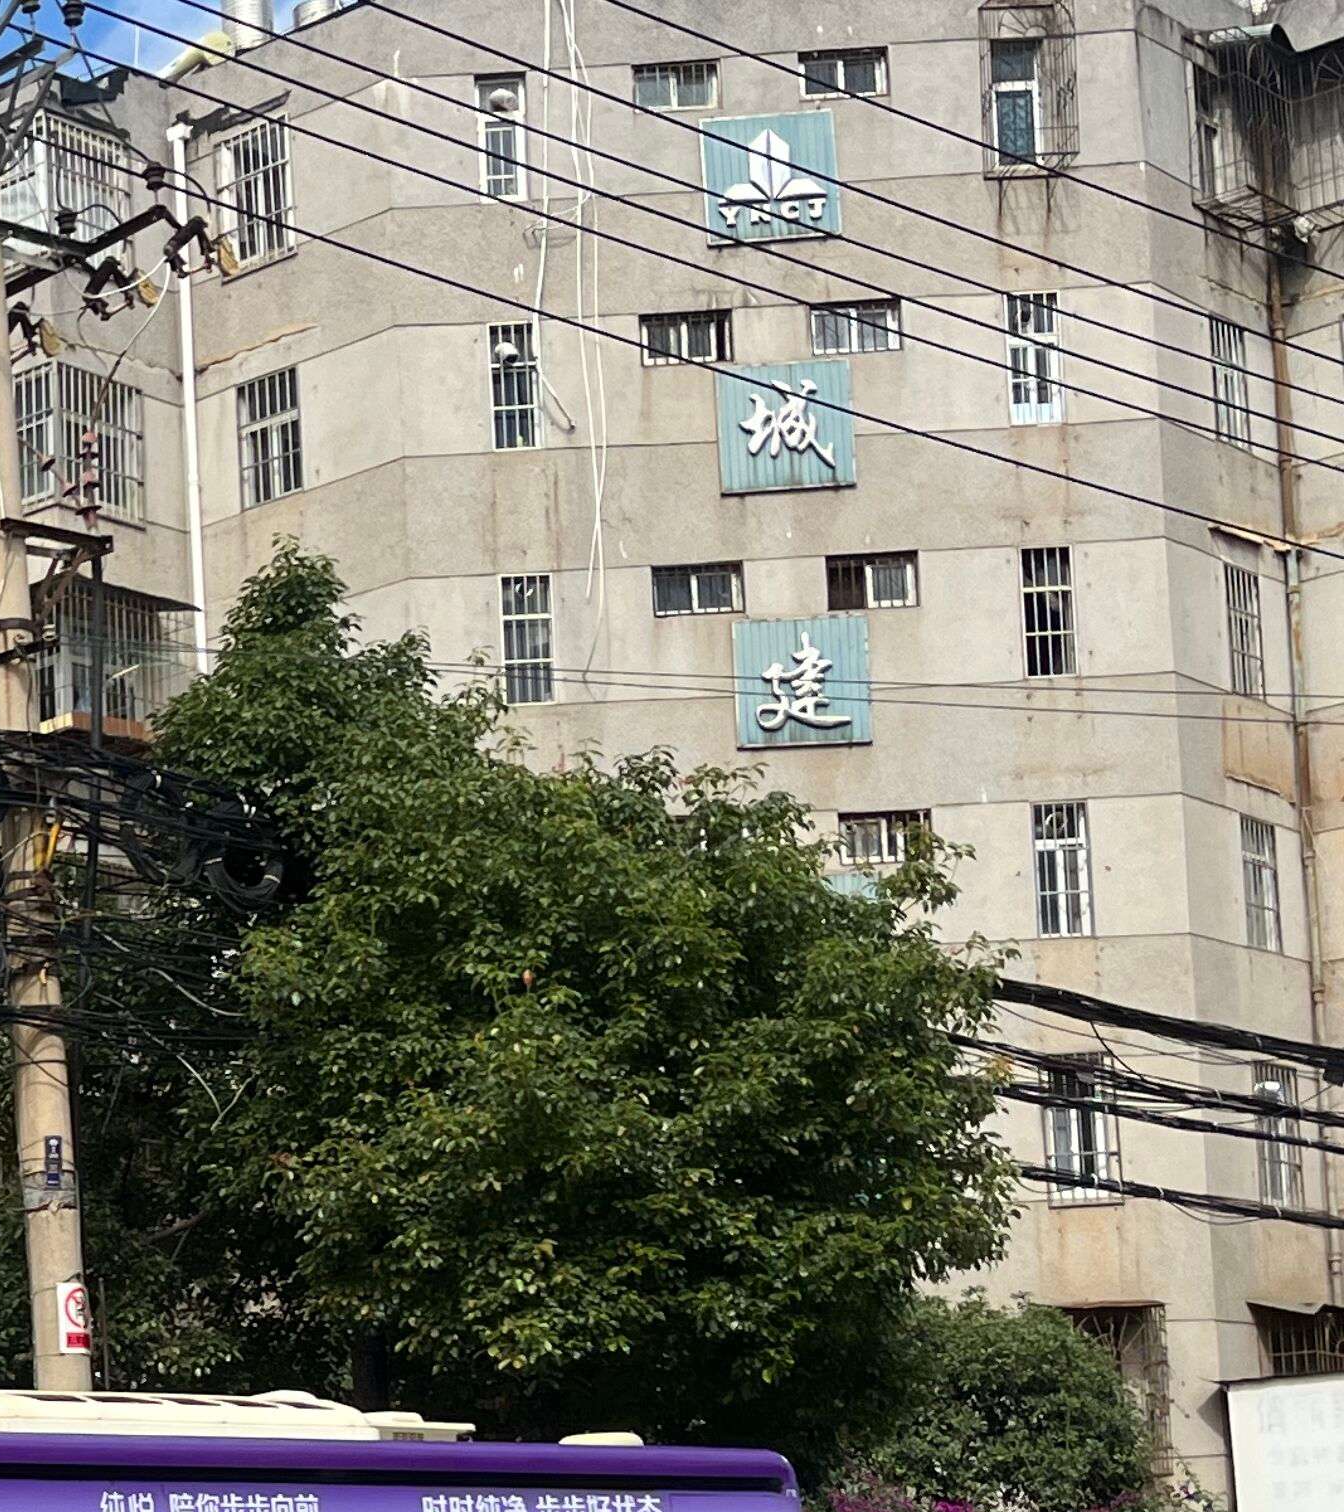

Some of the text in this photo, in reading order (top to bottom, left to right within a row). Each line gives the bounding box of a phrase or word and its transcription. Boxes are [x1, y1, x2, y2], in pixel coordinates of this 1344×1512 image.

[718, 200, 827, 226] YNCJ
[739, 379, 836, 467] 城
[755, 632, 852, 730] 建
